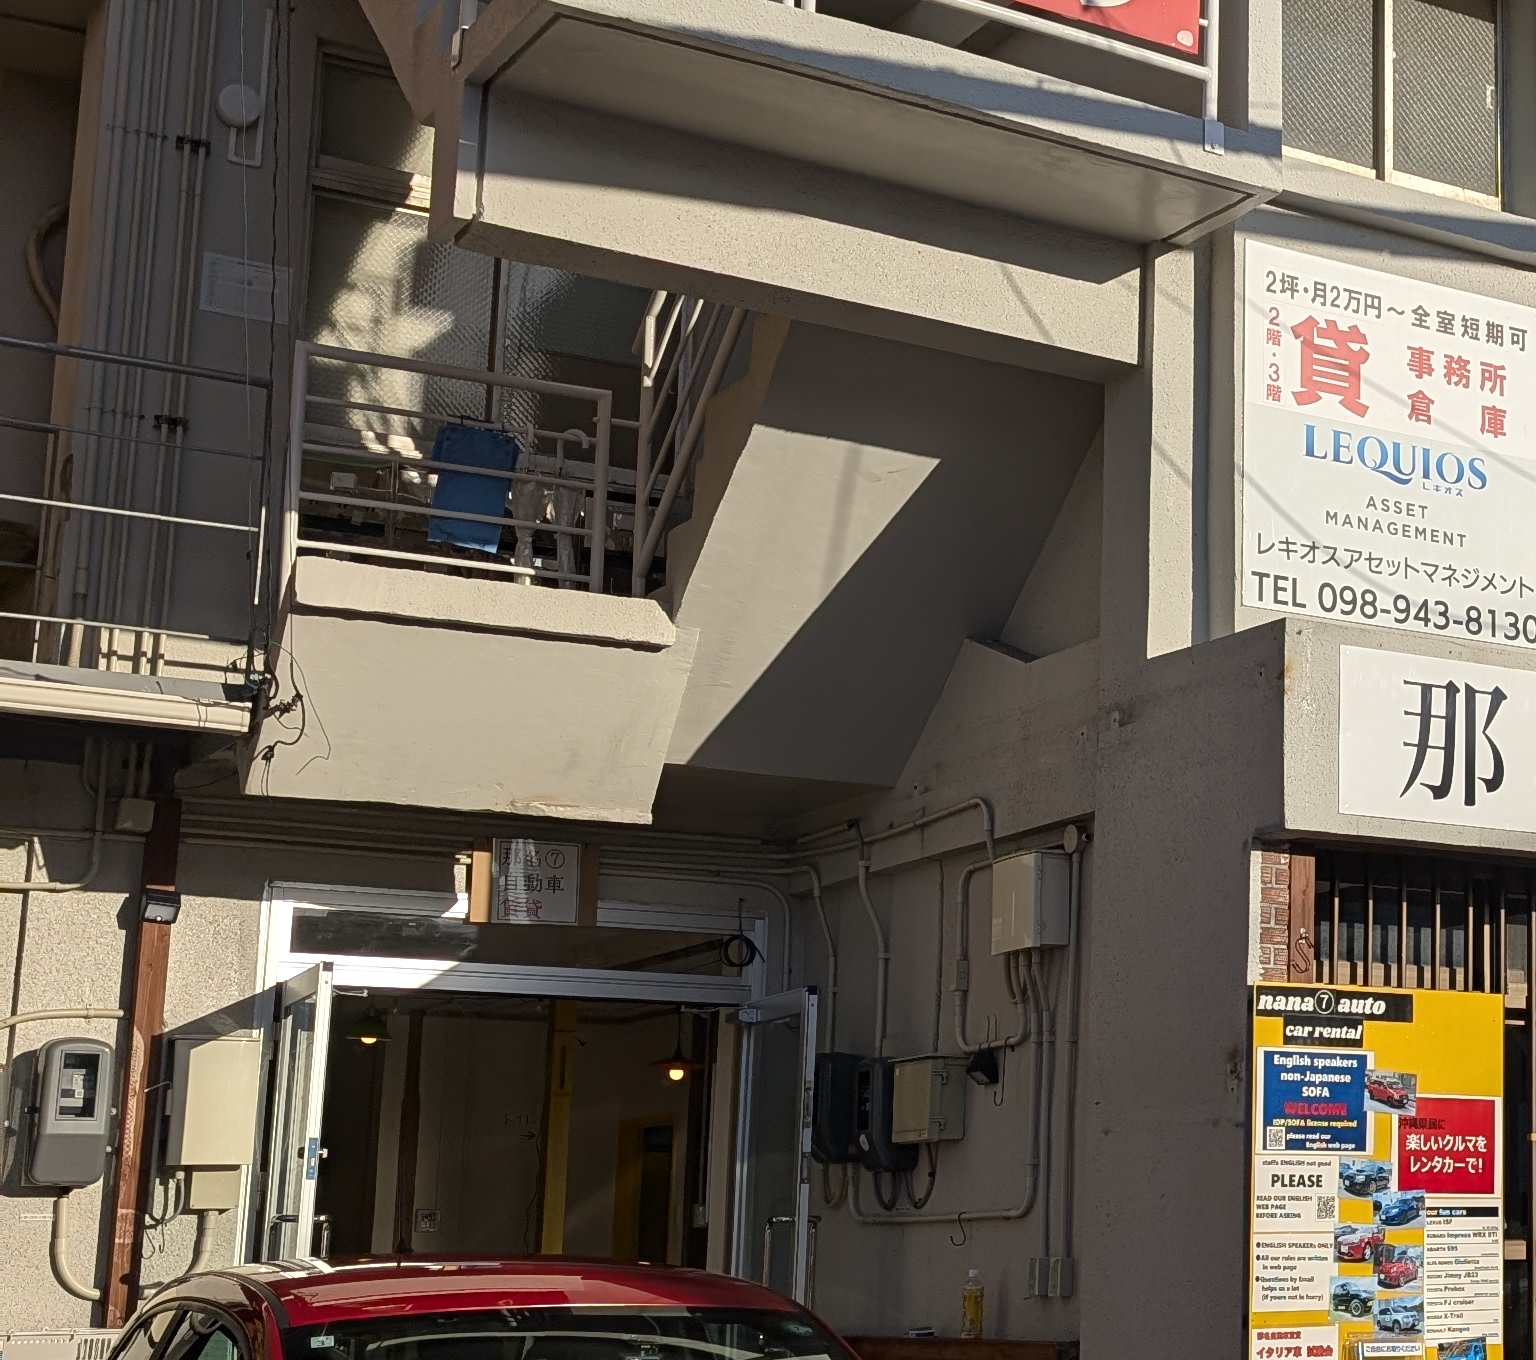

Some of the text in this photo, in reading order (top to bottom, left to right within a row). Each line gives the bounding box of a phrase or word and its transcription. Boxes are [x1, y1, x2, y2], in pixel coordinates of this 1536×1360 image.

[1265, 307, 1282, 403] 2階・3階
[1290, 314, 1370, 418] 貸
[1406, 345, 1507, 396] 事務所
[1302, 423, 1488, 490] LEQUIOS
[1422, 483, 1464, 497] レキオス
[1365, 495, 1429, 520] ASSET
[1325, 510, 1467, 548] MANAGEMENT
[1256, 532, 1535, 598] レキオスアセットマネジメント
[1251, 570, 1307, 610] TEL
[503, 874, 565, 894] 自動車
[1337, 997, 1386, 1015] auto
[1285, 1024, 1363, 1040] car rental
[1273, 1054, 1358, 1070] English speakers
[1280, 1071, 1351, 1085] non-Japanese
[1301, 1086, 1330, 1098] SOFA
[1284, 1101, 1347, 1115] WELCOME
[1405, 1133, 1488, 1153] 楽しいクルマを
[1270, 1173, 1323, 1188] PLEASE
[1256, 1345, 1303, 1360] イタリア車
